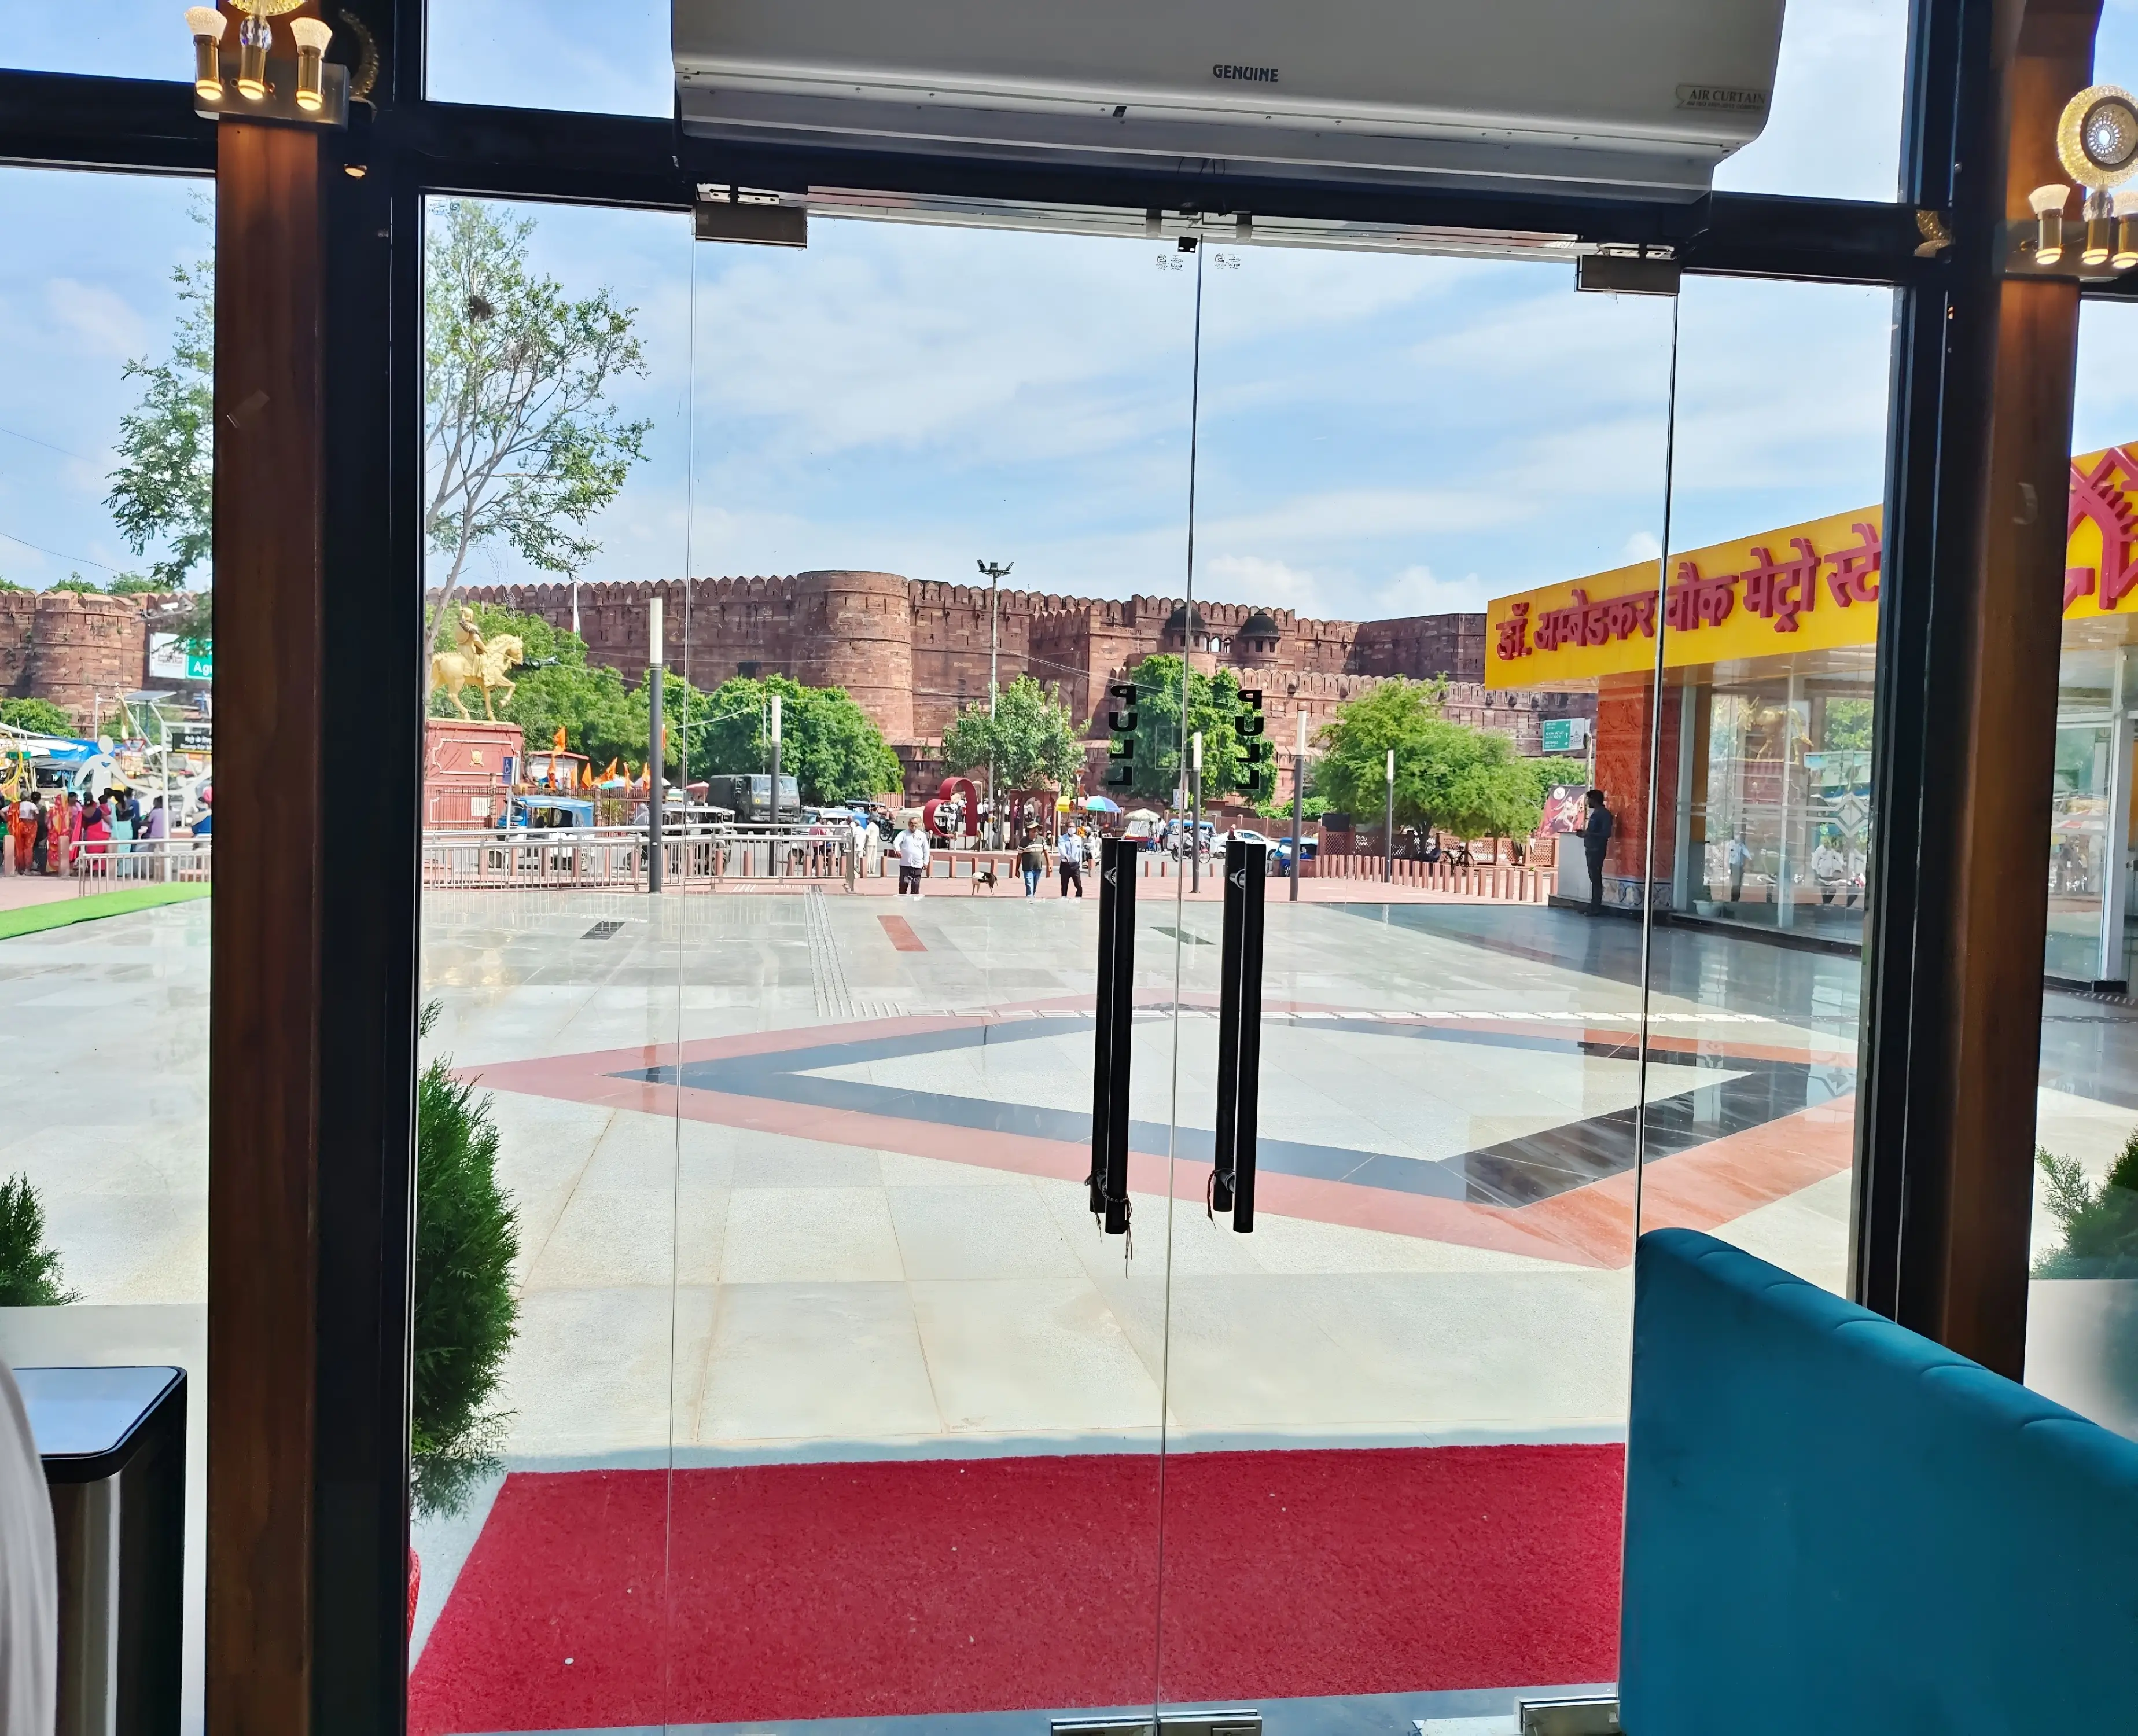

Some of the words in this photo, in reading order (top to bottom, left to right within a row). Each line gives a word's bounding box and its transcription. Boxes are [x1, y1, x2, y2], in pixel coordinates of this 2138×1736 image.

[1212, 64, 1279, 82] GENUINE
[1688, 89, 1709, 100] AIR
[1713, 90, 1767, 104] CURTAIN
[1496, 602, 1532, 660] डॉ.
[1534, 589, 1659, 651] अम्बेडकर
[1740, 538, 1821, 632] मेट्रो
[1824, 523, 1882, 607] स्टे
